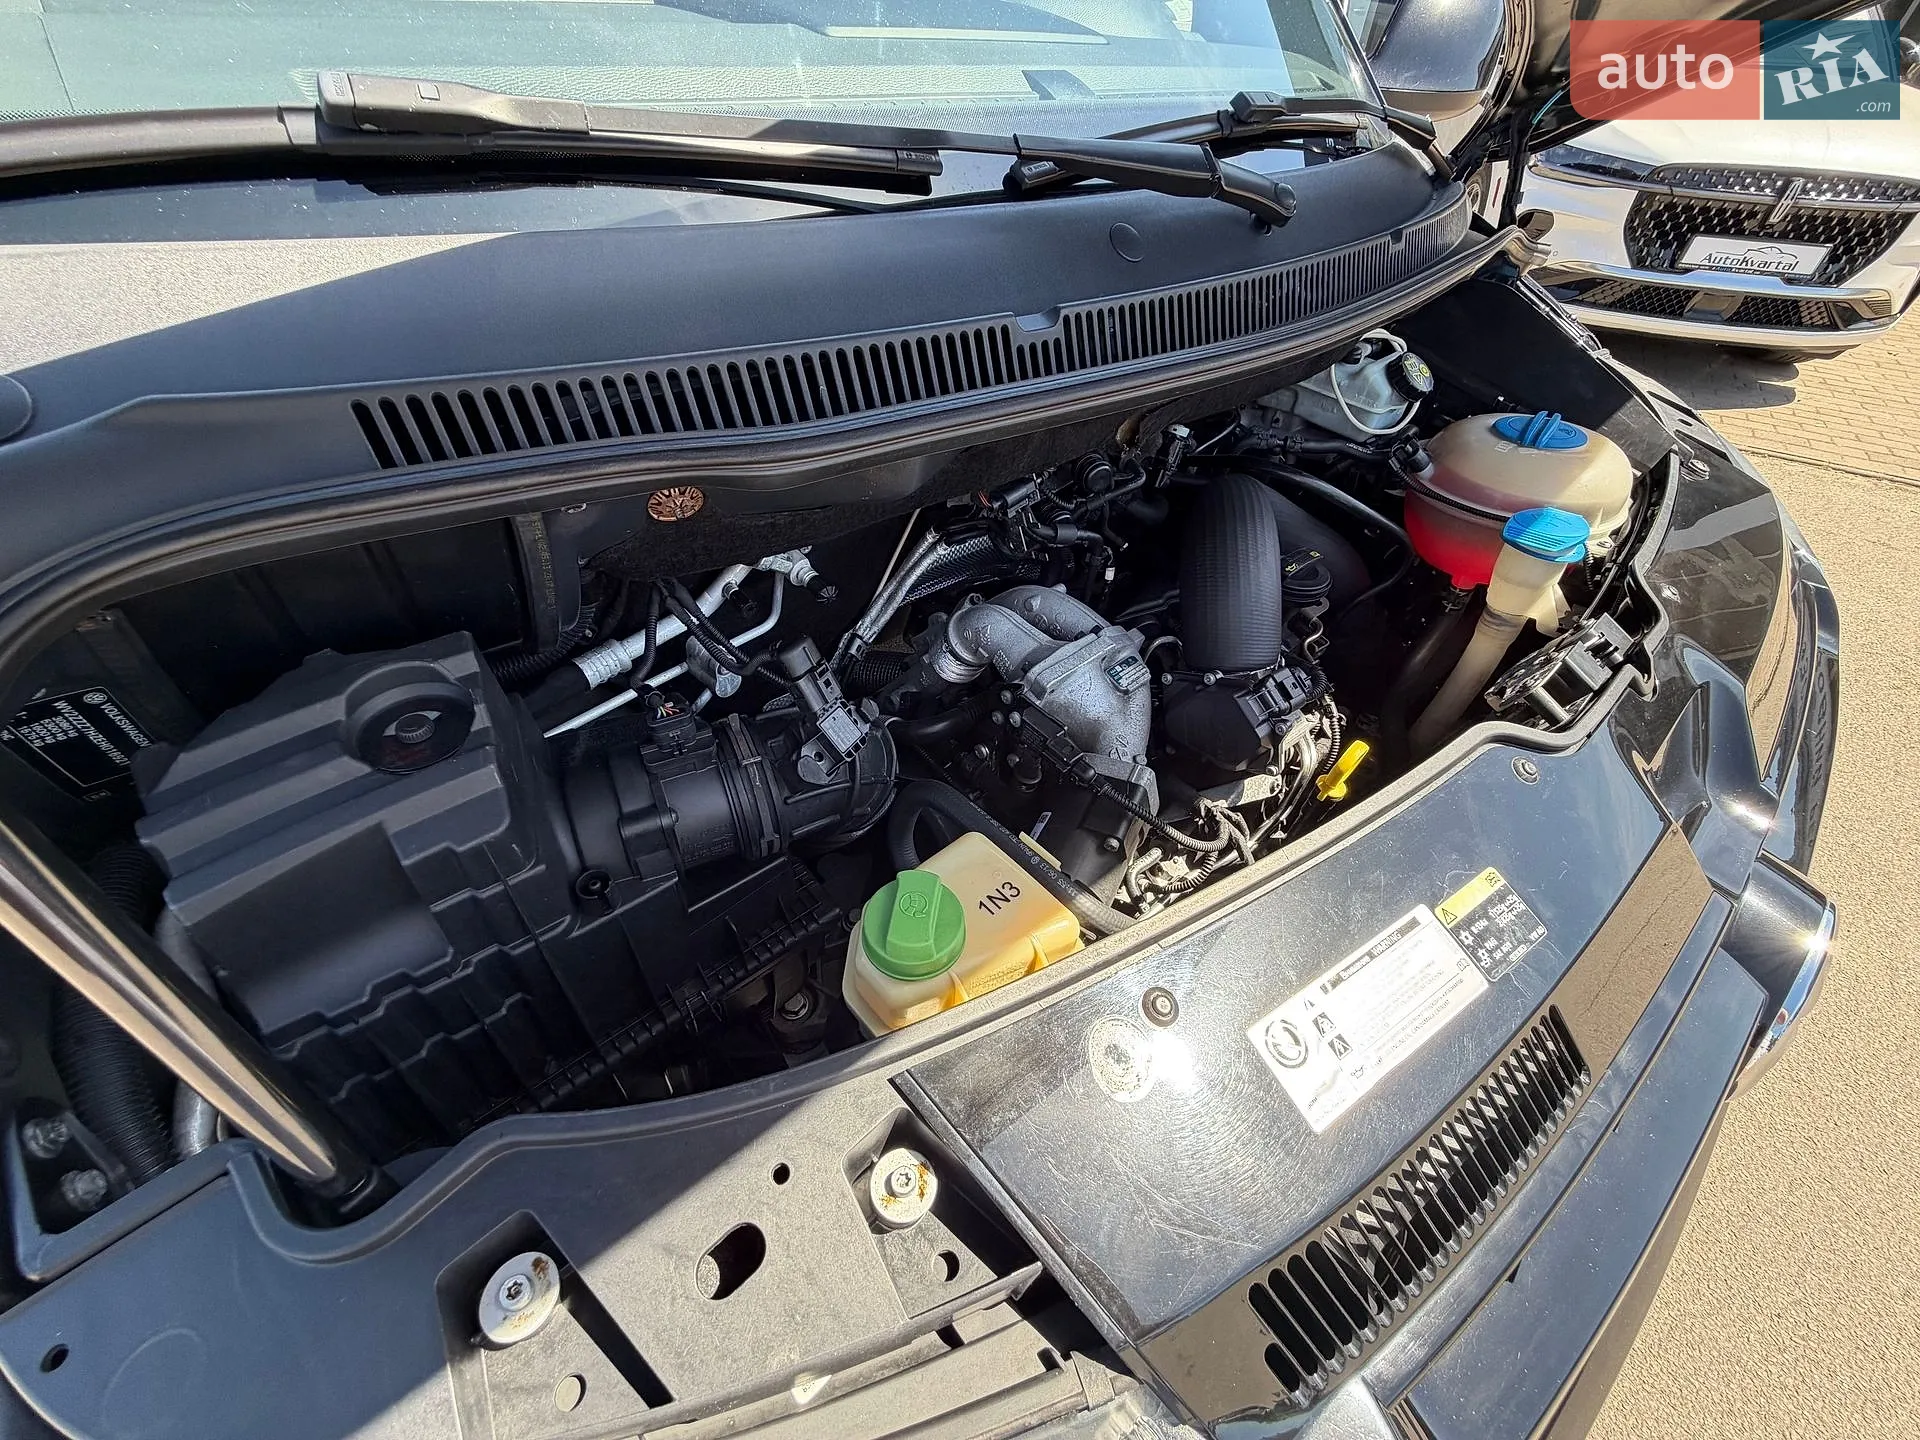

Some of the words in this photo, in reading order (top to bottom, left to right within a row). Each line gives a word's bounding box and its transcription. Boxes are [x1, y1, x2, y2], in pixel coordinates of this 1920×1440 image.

[1700, 252, 1800, 272] AutoKvartal
[100, 702, 154, 748] VOLKSWAGEN
[978, 881, 1021, 916] 1N3
[1370, 930, 1403, 957] WARNING
